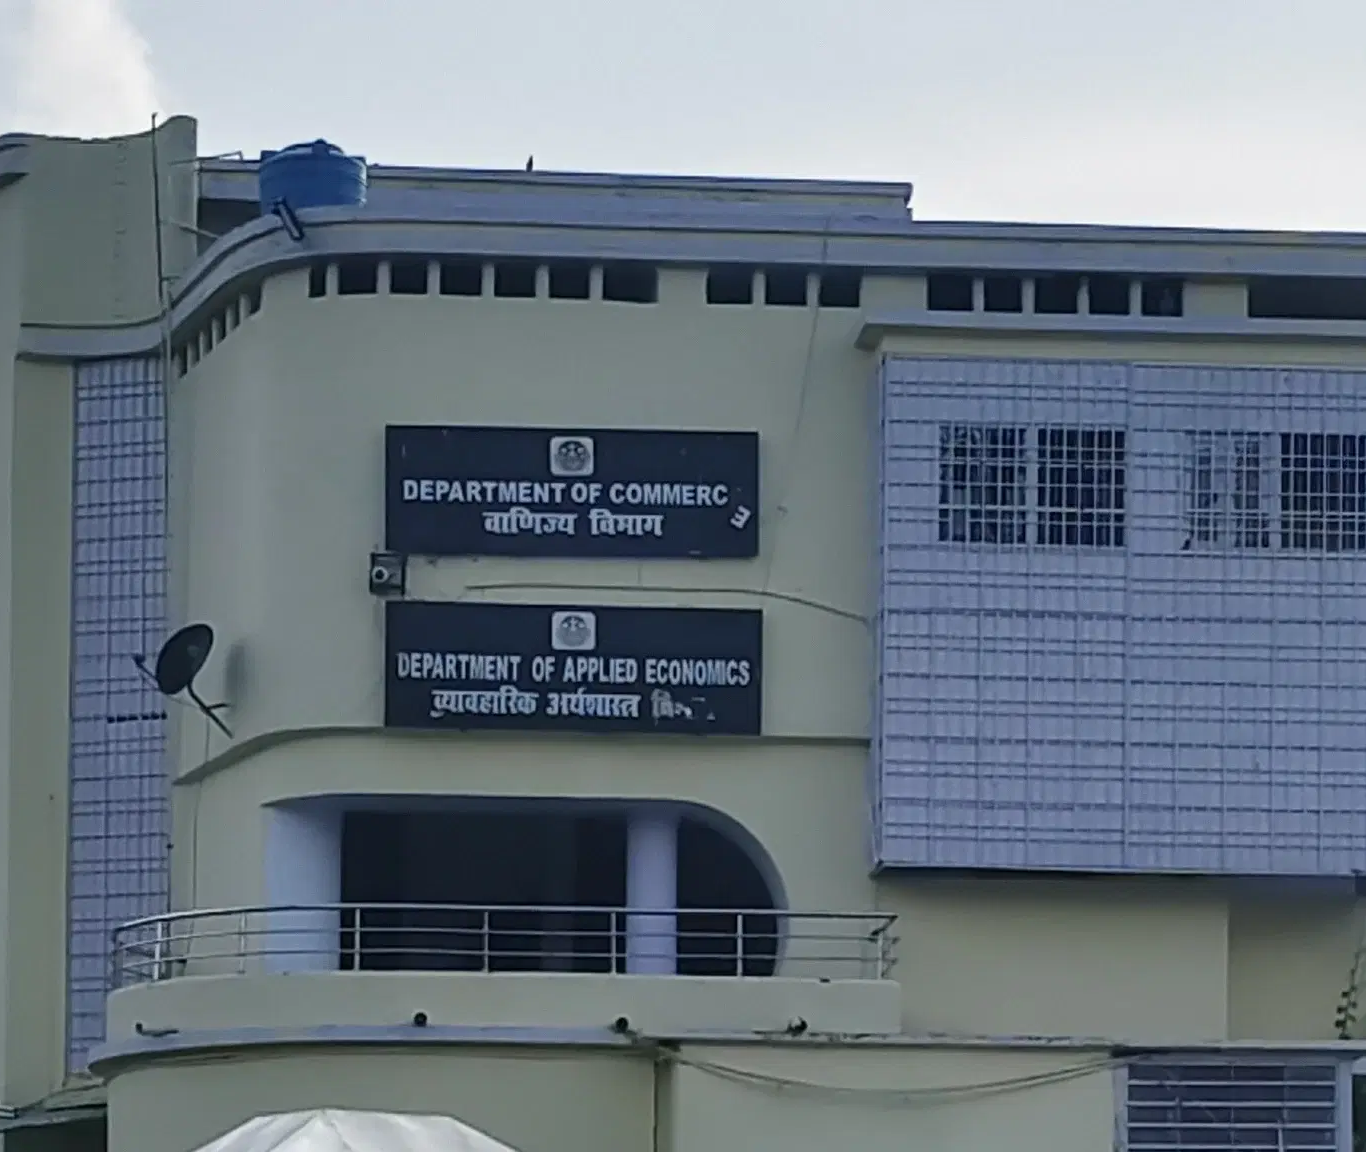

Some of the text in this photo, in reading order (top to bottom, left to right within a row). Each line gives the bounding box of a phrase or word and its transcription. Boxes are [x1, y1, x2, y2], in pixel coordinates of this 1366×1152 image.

[403, 479, 729, 506] DEPARTMENT OF COMMERC
[483, 507, 578, 535] वाणिज्य
[398, 653, 750, 686] DEPARTMENT OF APPLIED ECONOMICS
